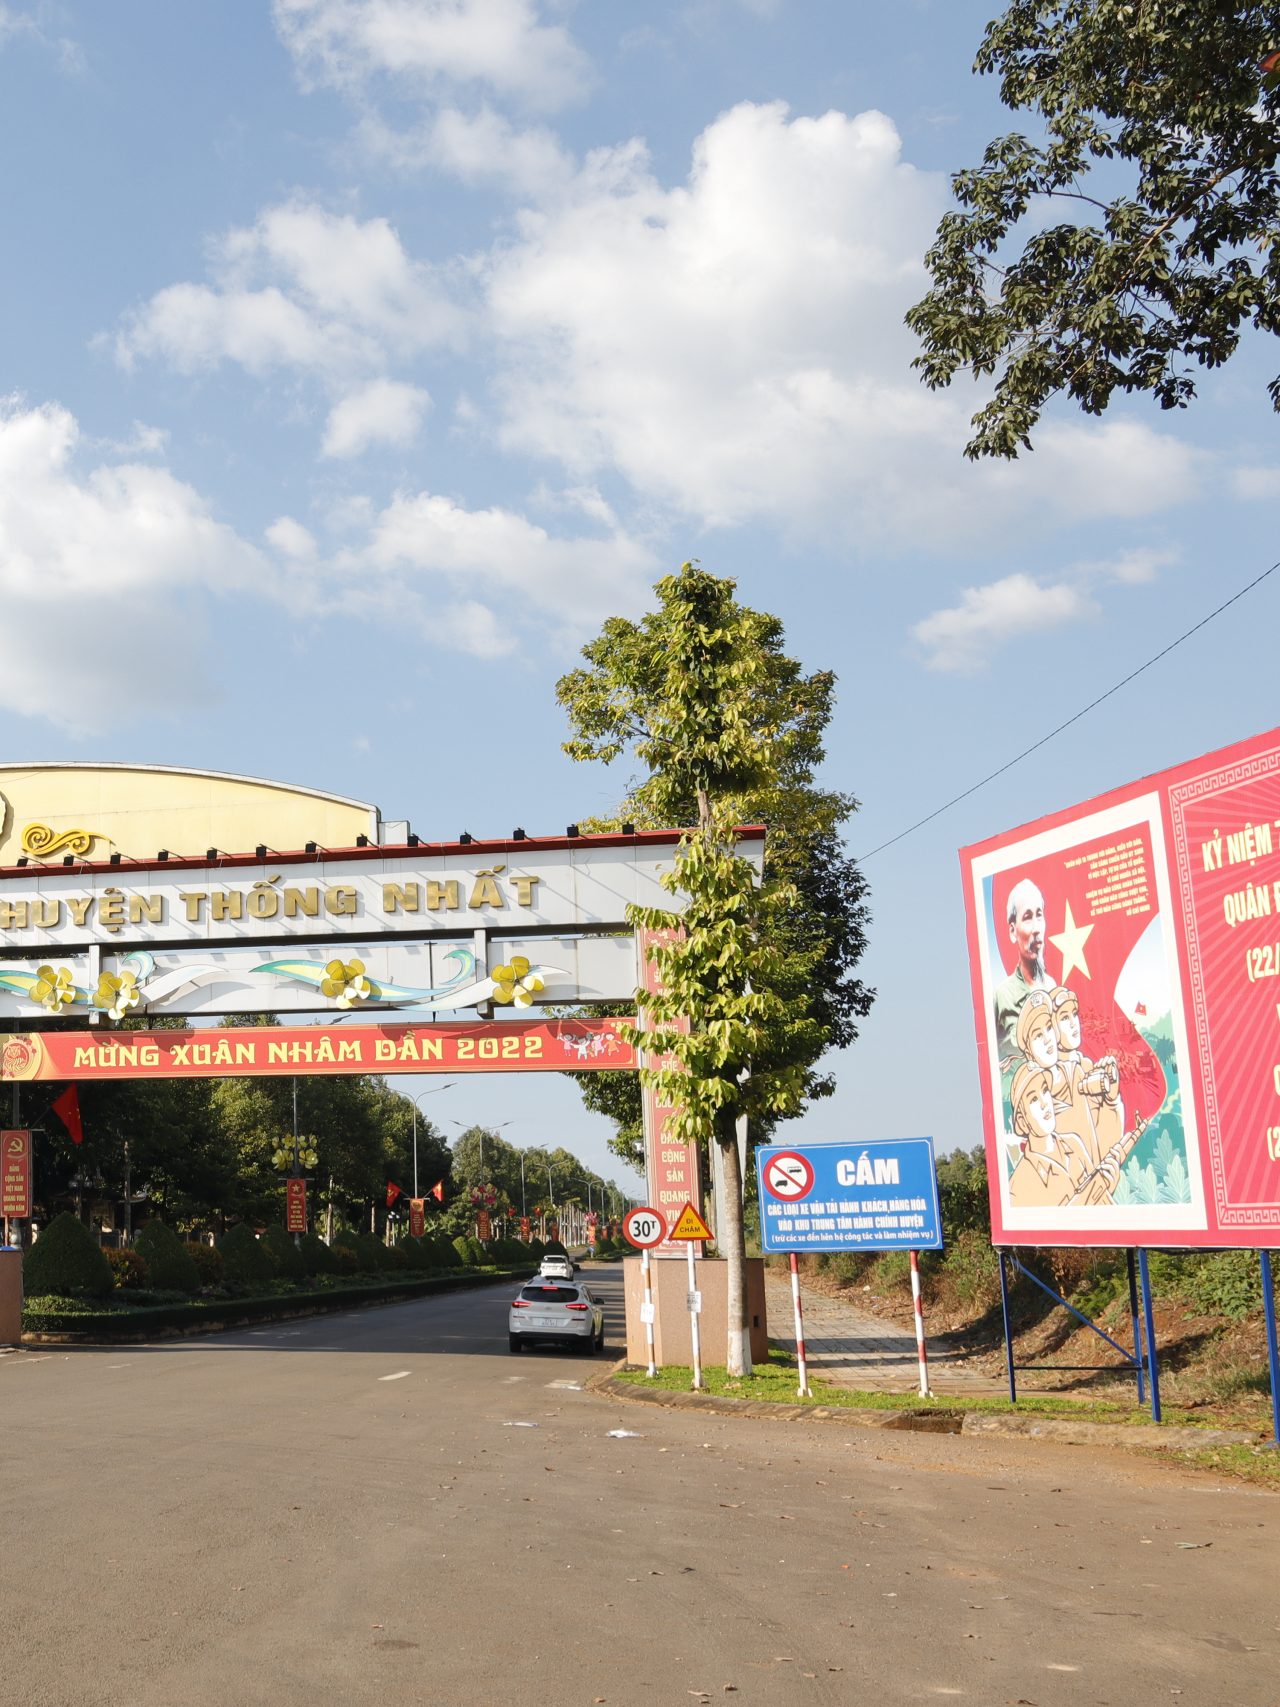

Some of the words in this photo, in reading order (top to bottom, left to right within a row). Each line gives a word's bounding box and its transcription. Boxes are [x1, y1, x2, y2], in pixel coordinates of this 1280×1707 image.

[1201, 828, 1223, 872] KỶ
[1226, 822, 1273, 867] NIỆM
[0, 887, 161, 932] HUYỆN
[178, 875, 357, 922] THỐNG
[382, 865, 538, 914] NHẤT
[1223, 882, 1271, 928] QUÂN
[73, 1041, 160, 1068] MỪNG
[169, 1038, 255, 1066] XUÂN
[267, 1035, 362, 1064] NHÂM
[372, 1030, 443, 1061] DẦN
[457, 1036, 543, 1060] 2022
[661, 1151, 686, 1166] CỘNG
[666, 1168, 685, 1182] SẢN
[836, 1150, 900, 1187] CẤM
[660, 1190, 690, 1205] QUANG
[665, 1209, 682, 1222] VIN
[799, 1203, 810, 1215] XE
[810, 1218, 835, 1231] TRUNG
[835, 1215, 853, 1230] TÂM
[852, 1215, 874, 1229] HÀNH
[874, 1214, 898, 1229] CHÍNH
